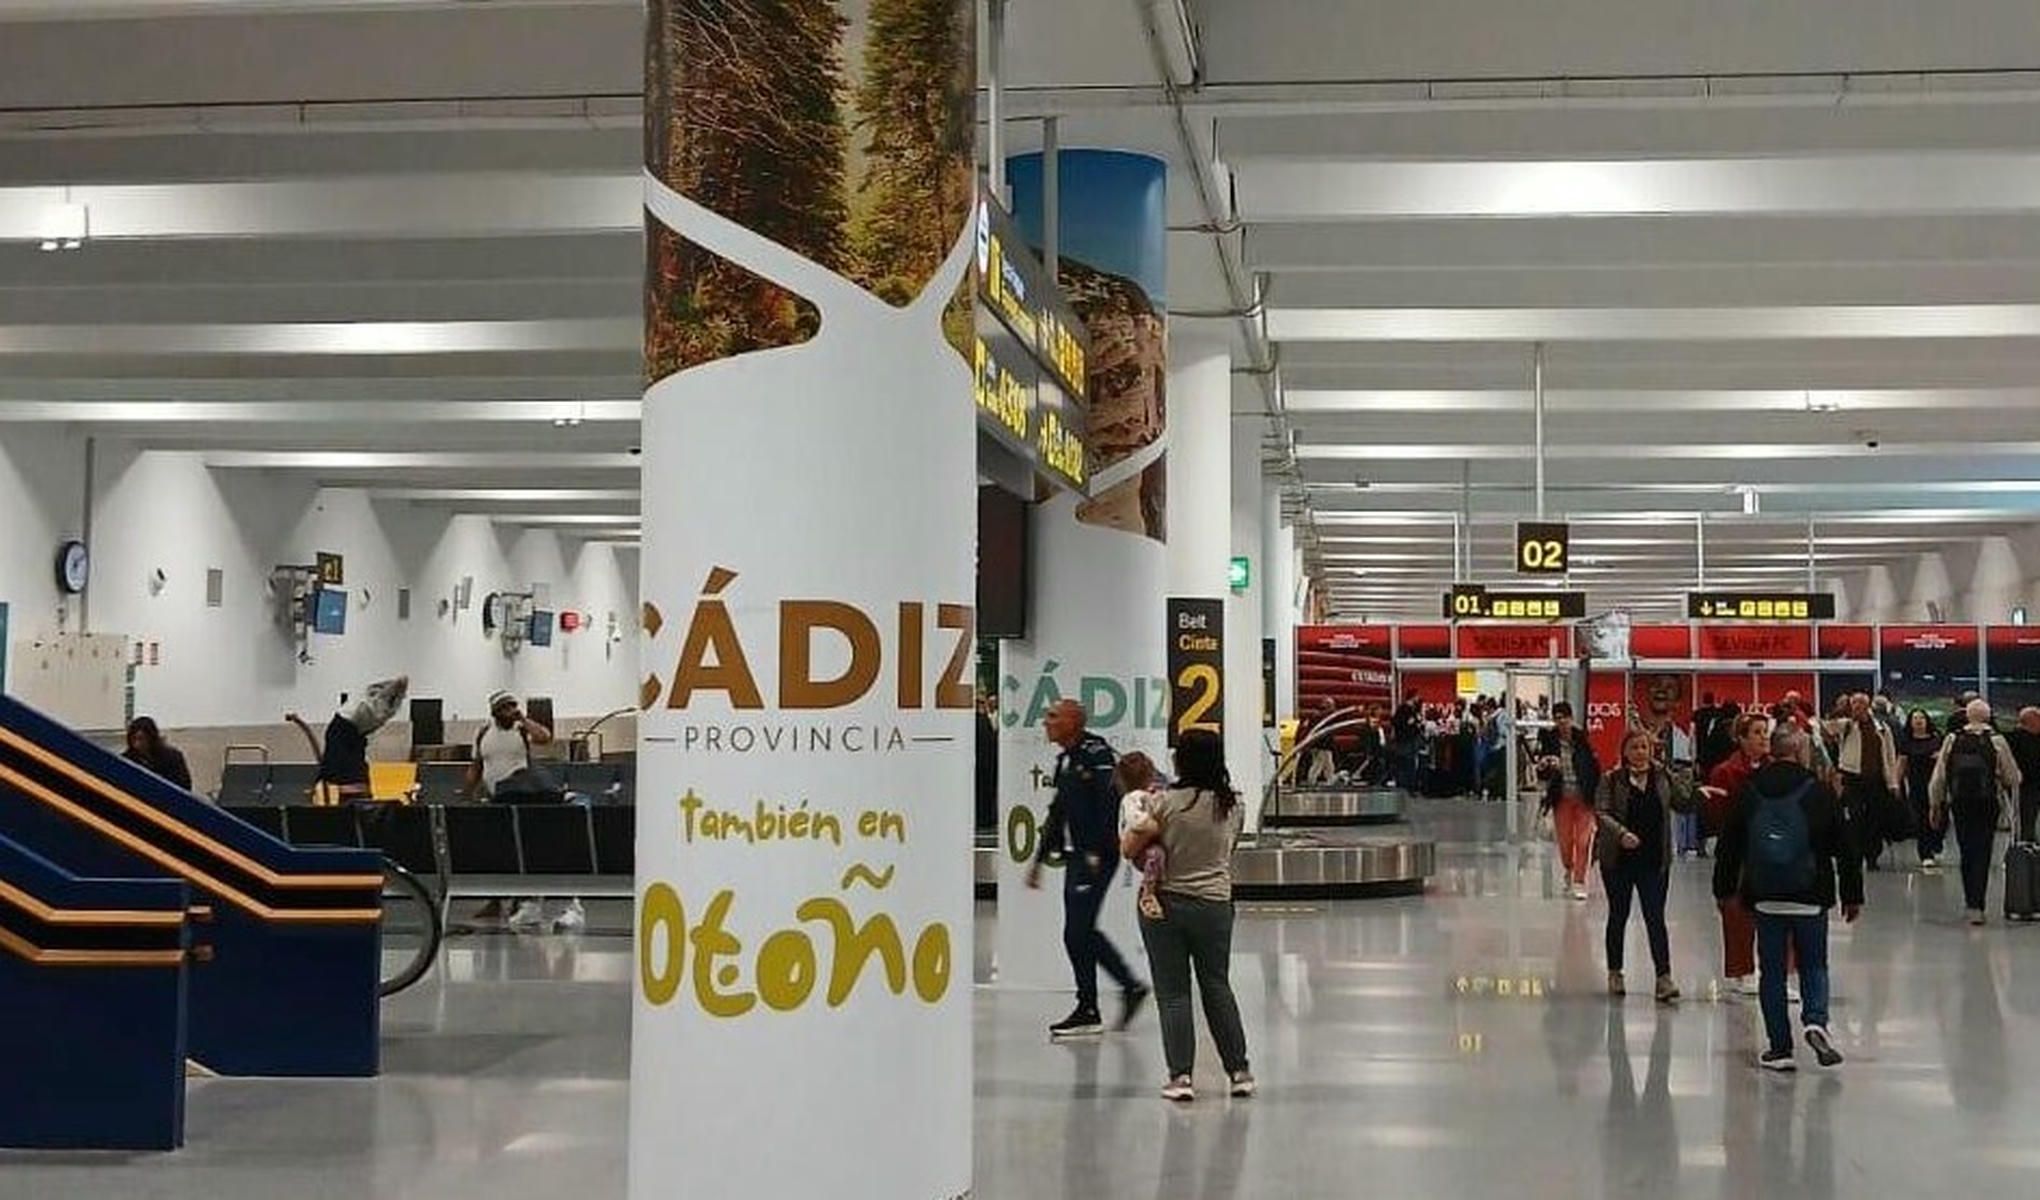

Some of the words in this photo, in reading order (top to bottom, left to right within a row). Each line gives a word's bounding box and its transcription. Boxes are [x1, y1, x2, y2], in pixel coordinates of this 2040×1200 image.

[1523, 540, 1563, 568] 02
[1455, 595, 1480, 614] 01
[1178, 612, 1207, 629] Belt
[1178, 664, 1221, 735] 2
[684, 726, 906, 753] PROVINCIA
[679, 788, 842, 845] también
[858, 809, 906, 843] en
[640, 863, 951, 1018] Otoño
